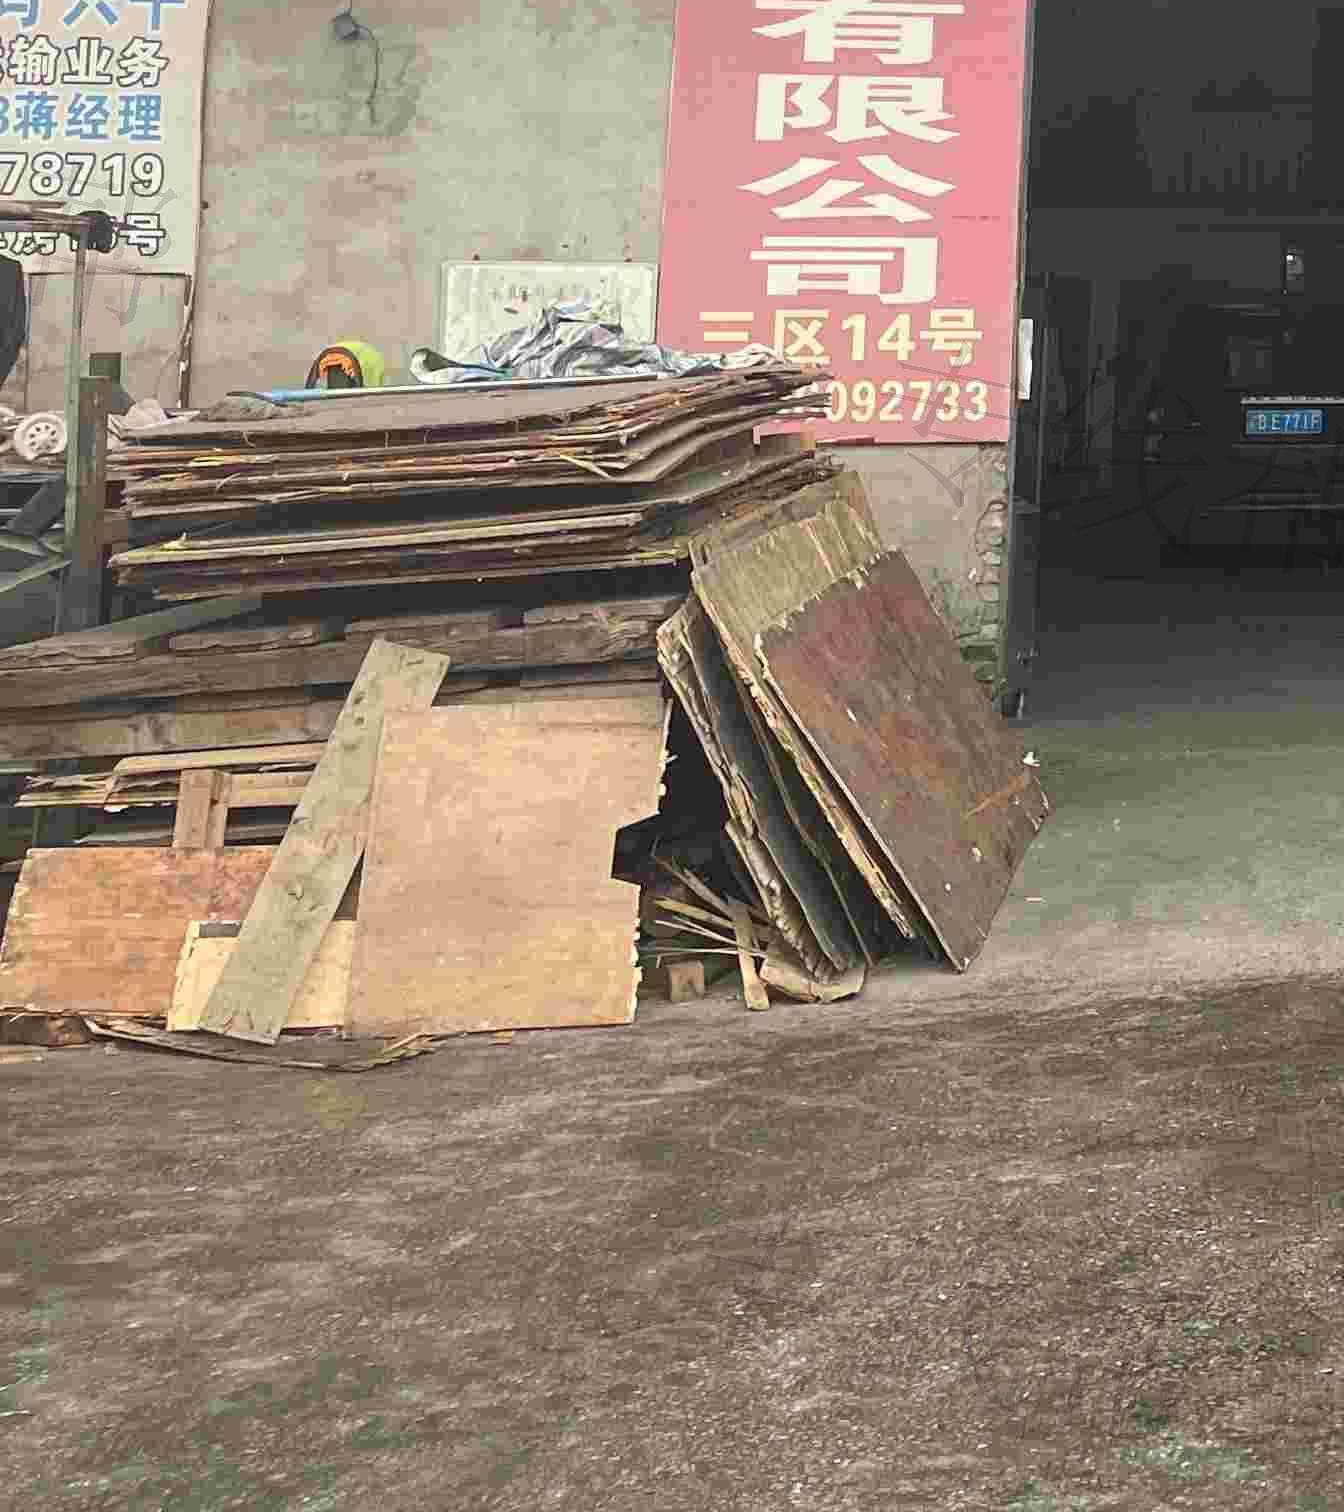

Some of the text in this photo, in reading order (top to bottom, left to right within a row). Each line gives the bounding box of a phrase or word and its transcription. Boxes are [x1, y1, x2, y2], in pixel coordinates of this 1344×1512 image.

[0, 34, 171, 89] 输业务
[0, 151, 166, 197] 78719
[803, 378, 988, 424] 092733
